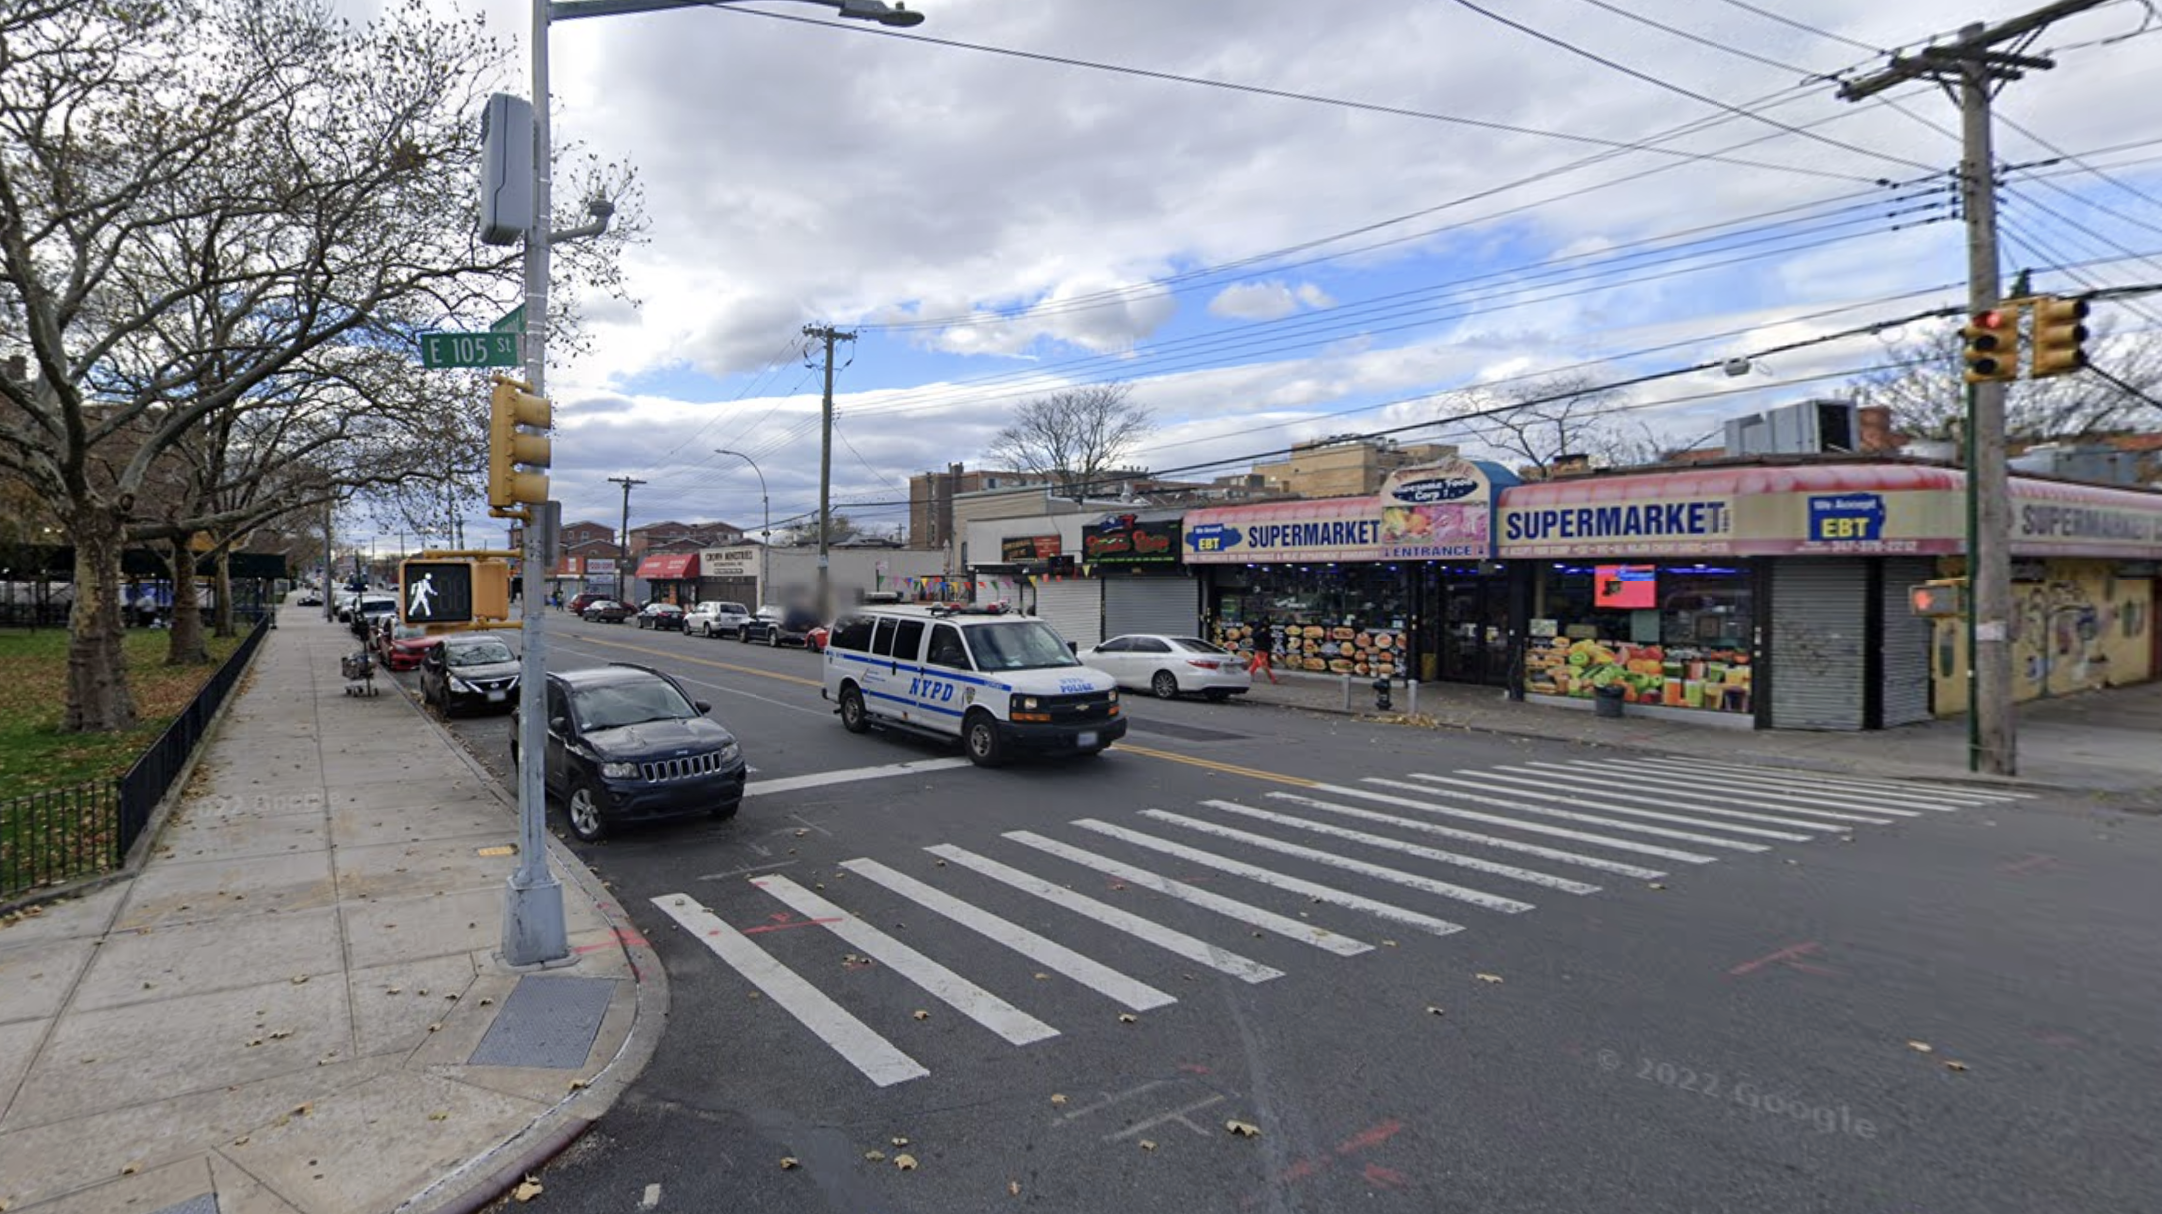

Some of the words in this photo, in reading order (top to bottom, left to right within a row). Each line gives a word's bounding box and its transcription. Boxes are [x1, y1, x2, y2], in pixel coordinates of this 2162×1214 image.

[430, 338, 442, 364] E
[452, 337, 488, 363] 105
[496, 336, 511, 353] St
[1506, 502, 1725, 540] SUPERMARKET
[1823, 517, 1870, 538] EBT
[1199, 537, 1219, 550] EBT
[1248, 520, 1381, 548] SUPERMARKET
[1394, 545, 1472, 557] ENTRANCE
[909, 677, 954, 702] NYPD
[1060, 683, 1095, 693] POLICE
